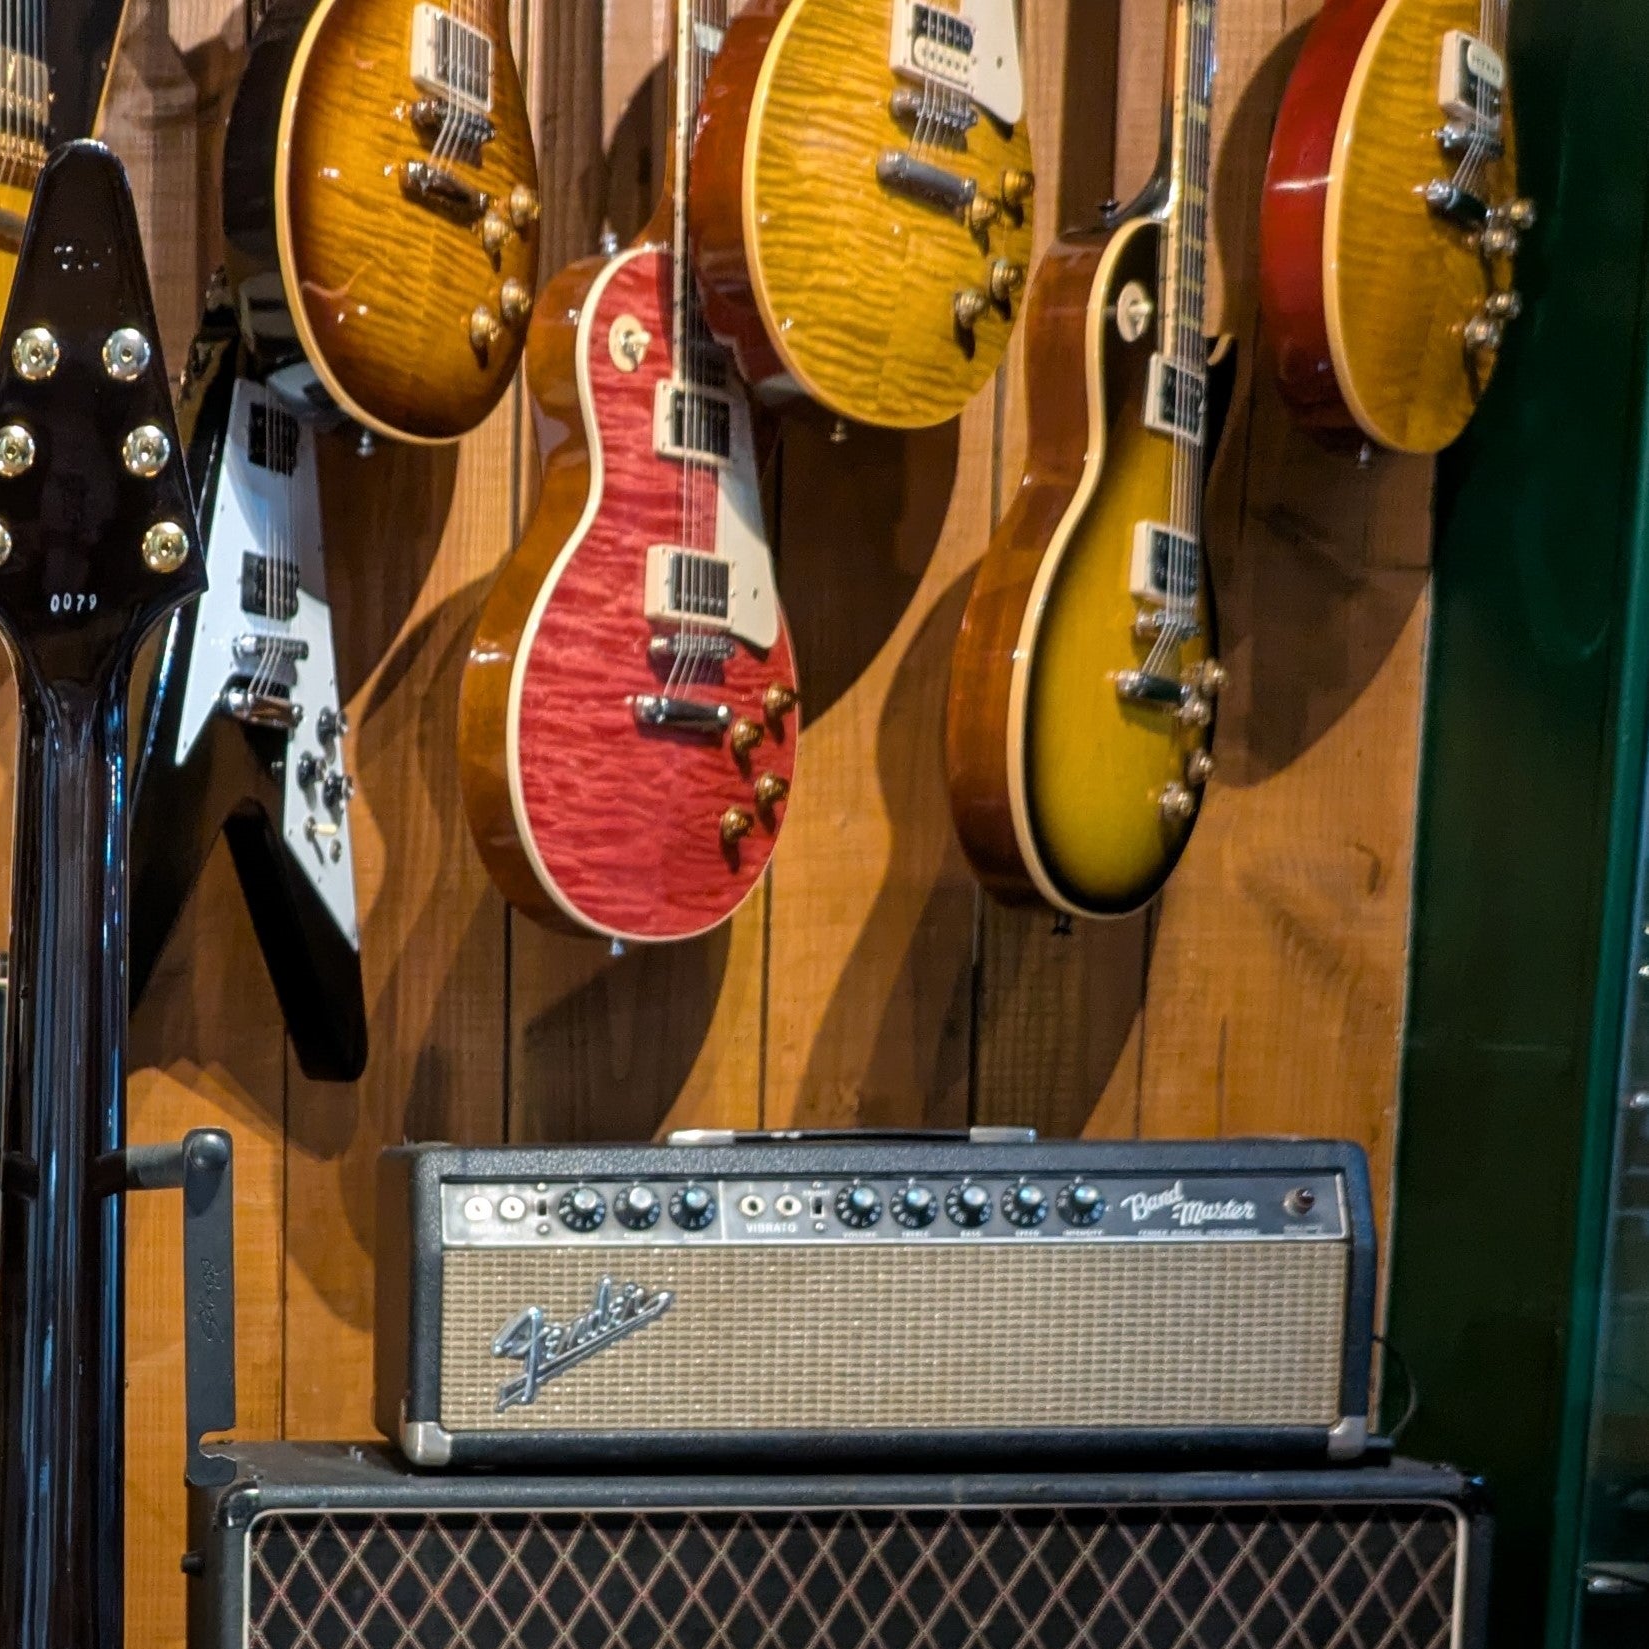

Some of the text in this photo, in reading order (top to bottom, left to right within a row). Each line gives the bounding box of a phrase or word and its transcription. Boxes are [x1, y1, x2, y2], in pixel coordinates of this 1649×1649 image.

[50, 592, 97, 613] 0079
[1120, 1179, 1256, 1226] Band Master
[745, 1221, 798, 1233] VIBRATO
[491, 1274, 675, 1413] Fender
